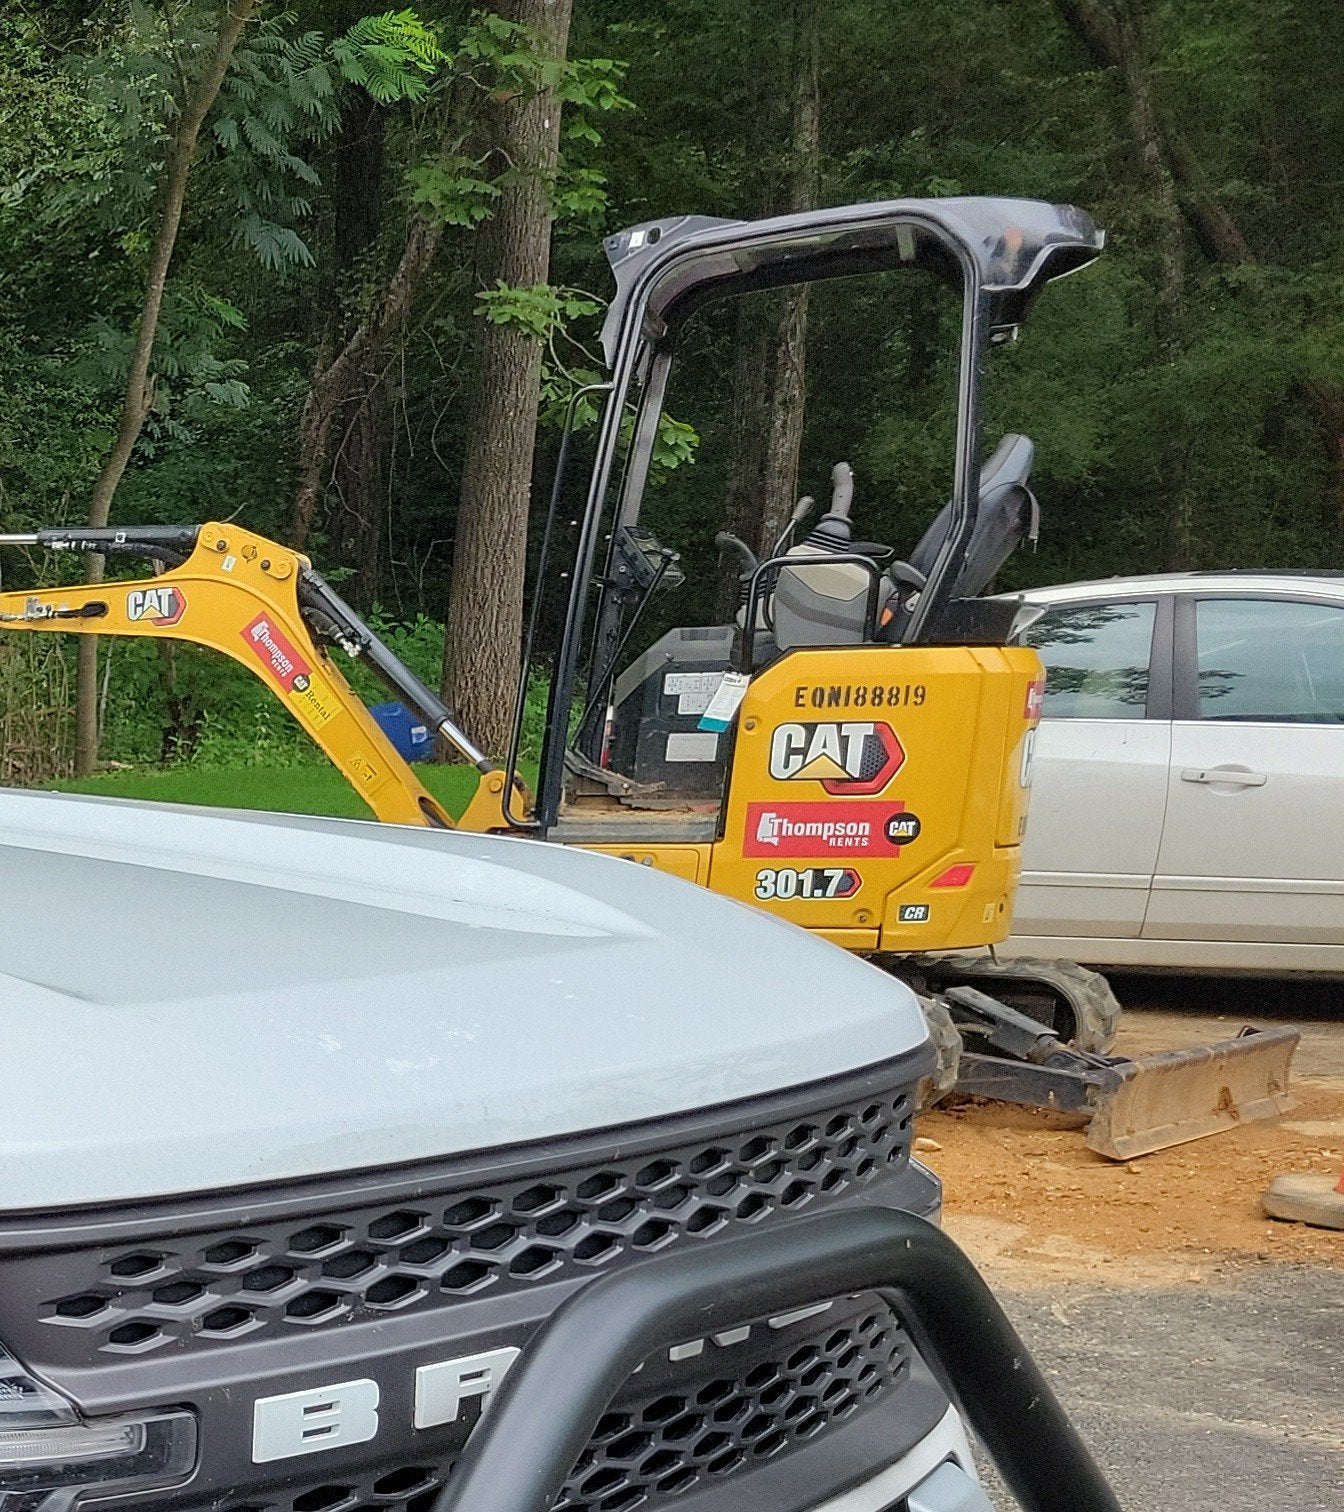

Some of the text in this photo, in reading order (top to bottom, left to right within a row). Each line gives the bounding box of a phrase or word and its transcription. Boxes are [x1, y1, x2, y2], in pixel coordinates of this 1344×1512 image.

[128, 587, 174, 621] CAT
[260, 624, 294, 674] Thompson
[293, 675, 308, 691] CAT
[770, 722, 876, 780] CAT
[770, 817, 871, 841] Thompson
[888, 820, 916, 837] CAT
[828, 836, 869, 847] RENTS
[756, 868, 845, 899] 301.7
[903, 906, 925, 920] CR
